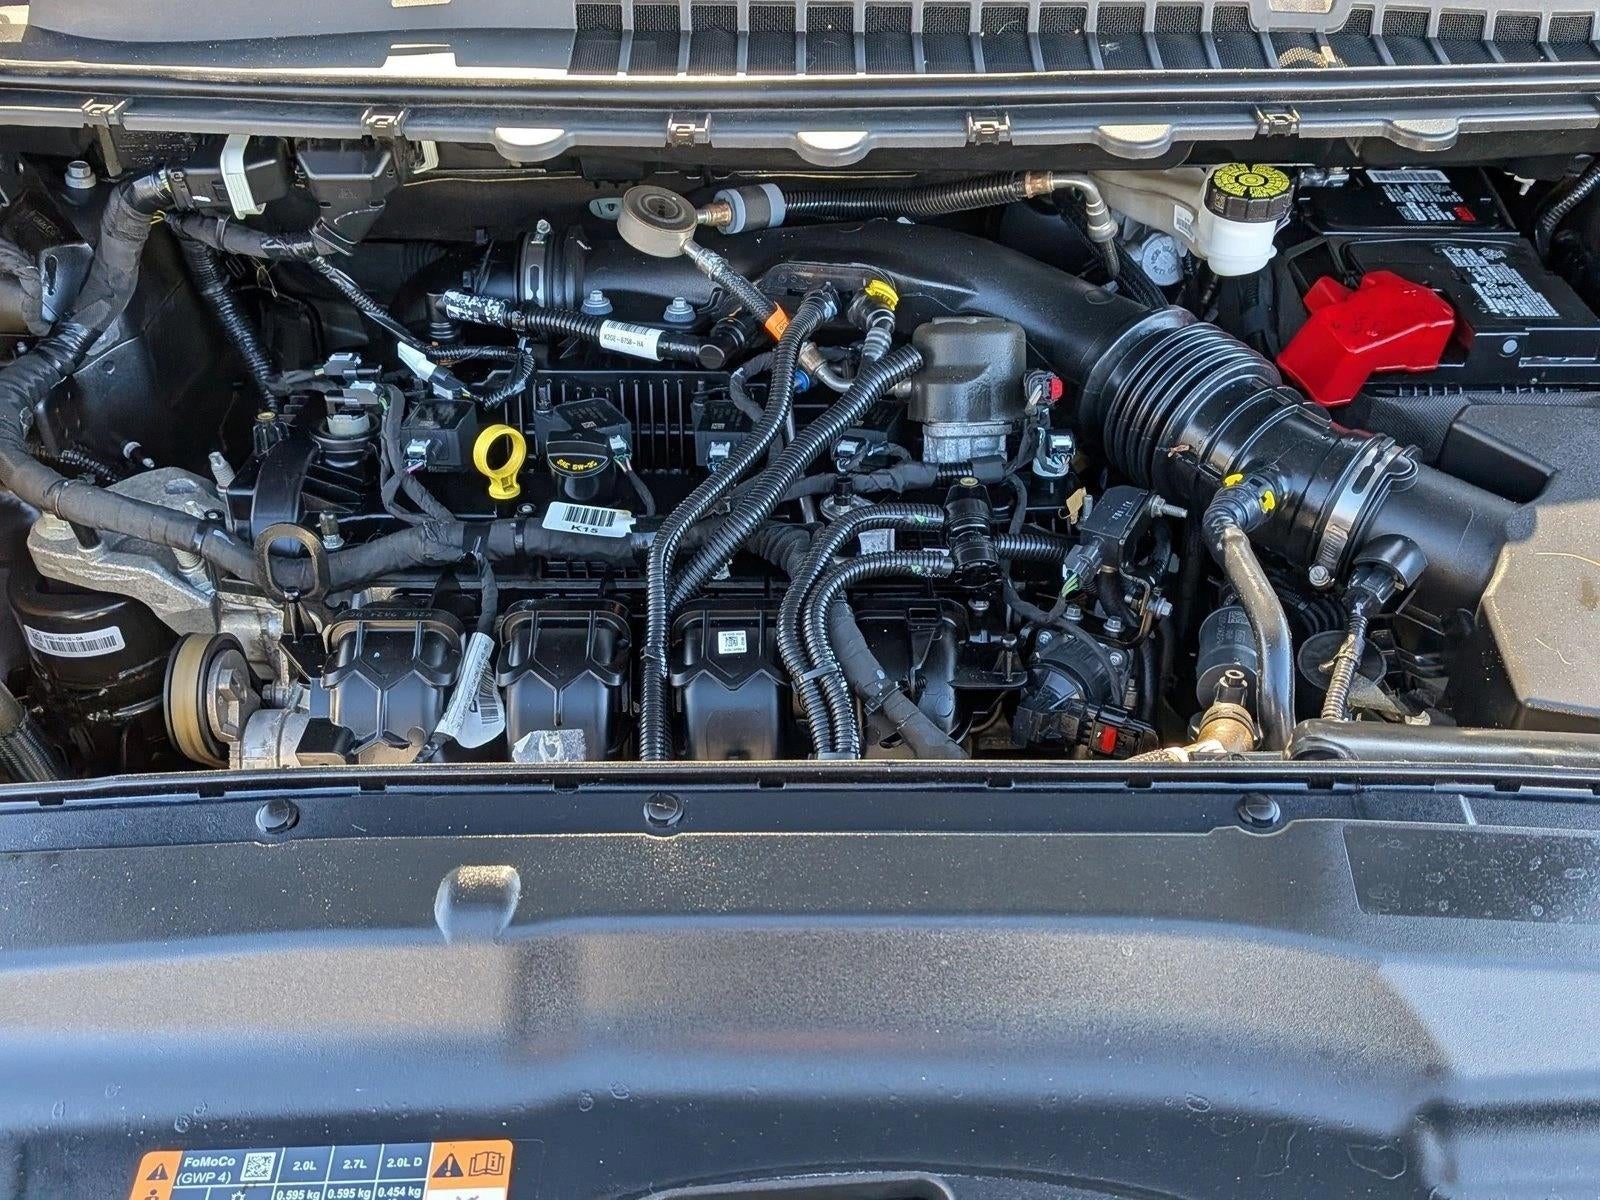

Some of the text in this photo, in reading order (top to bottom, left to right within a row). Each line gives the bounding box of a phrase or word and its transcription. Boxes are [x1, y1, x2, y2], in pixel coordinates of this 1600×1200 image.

[571, 524, 599, 534] K15
[183, 1156, 236, 1168] FoMoCo
[292, 1161, 318, 1171] 2.0L
[342, 1159, 368, 1170] 2.7L
[386, 1157, 423, 1168] 2.0L D
[176, 1171, 232, 1186] (GWP 4)
[276, 1189, 321, 1200] 0.595 kg
[327, 1187, 372, 1200] 0.595 kg
[377, 1186, 422, 1199] 0.454 kg
